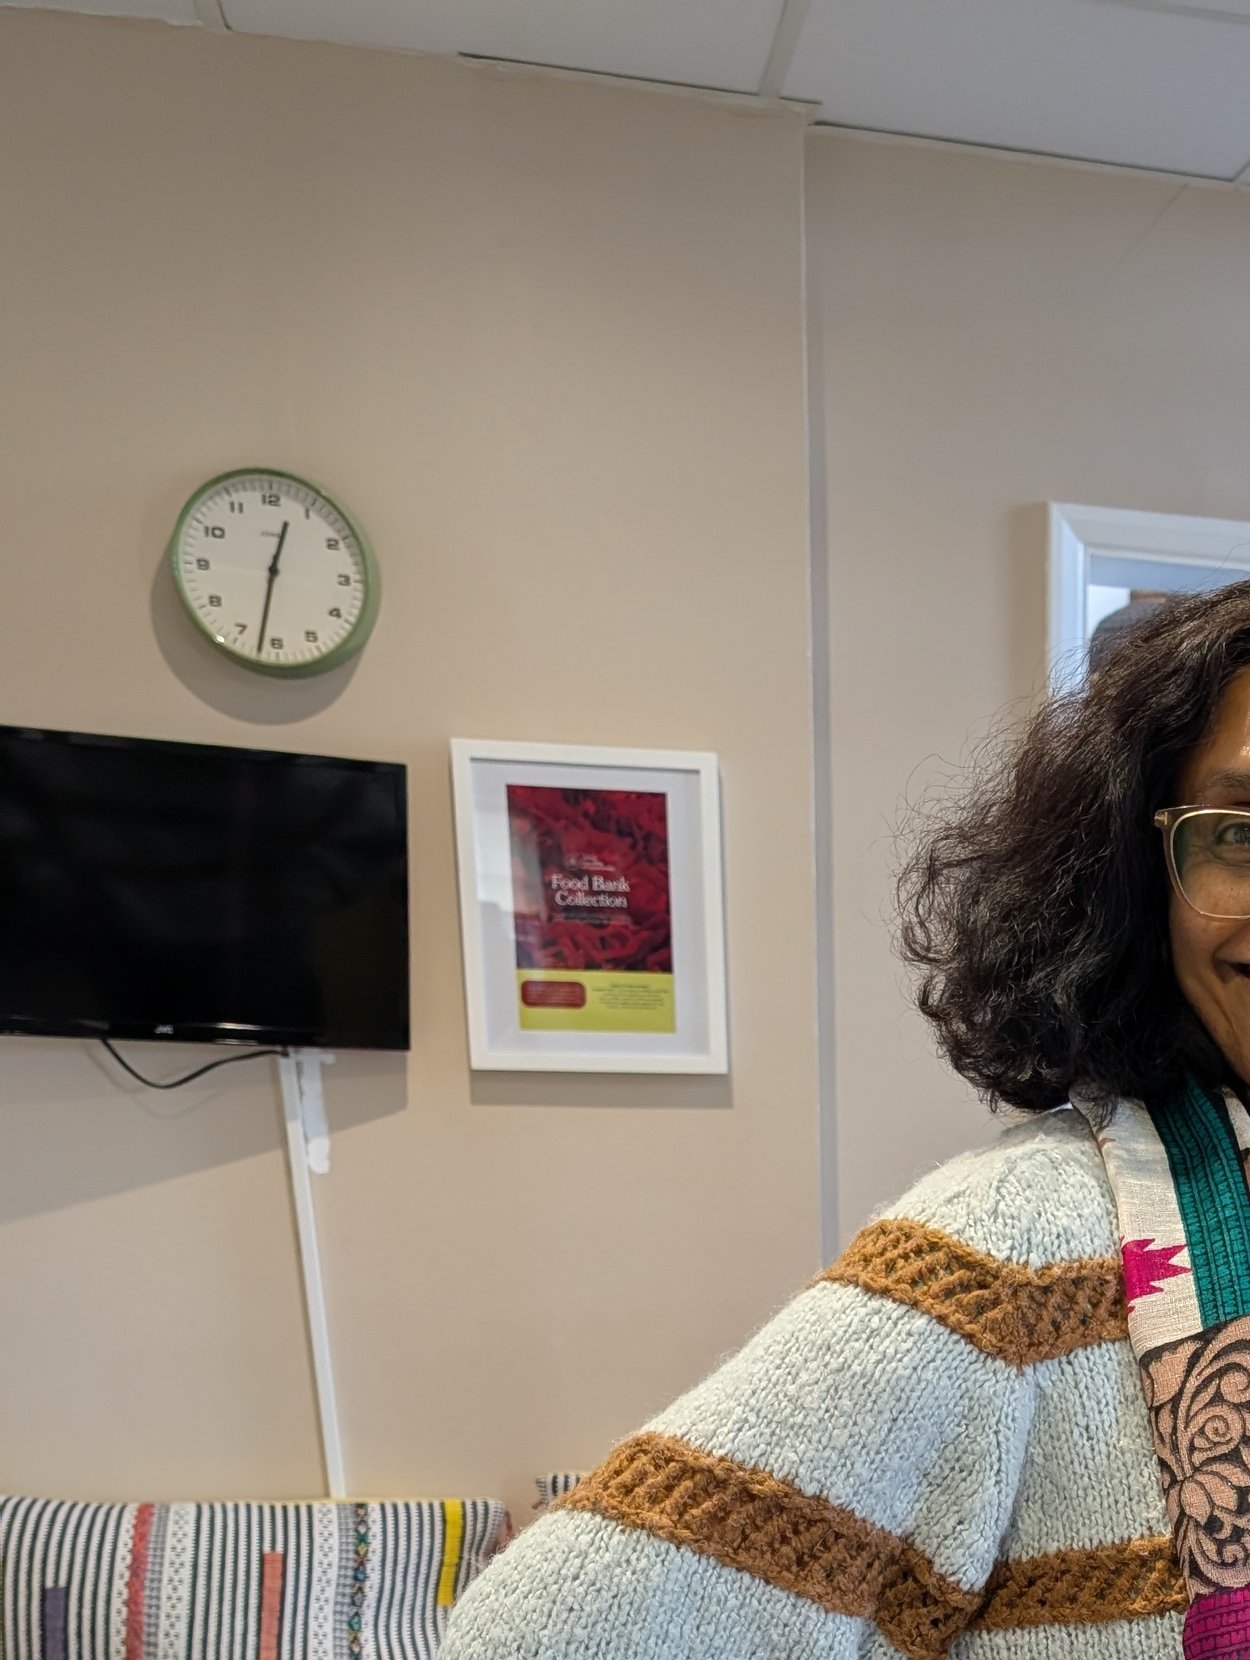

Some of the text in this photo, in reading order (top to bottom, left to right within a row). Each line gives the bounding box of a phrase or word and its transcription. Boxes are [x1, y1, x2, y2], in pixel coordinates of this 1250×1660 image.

[262, 495, 280, 506] 12
[231, 501, 243, 513] 11
[304, 508, 310, 520] 1
[205, 527, 225, 539] 10
[327, 538, 340, 550] 2
[197, 559, 210, 570] 9
[338, 575, 350, 586] 3
[210, 596, 222, 607] 8
[329, 608, 342, 618] 4
[235, 623, 247, 635] 7
[305, 631, 318, 642] 5
[271, 638, 283, 649] 6
[551, 873, 630, 892] Food Bank
[555, 889, 628, 908] Collection
